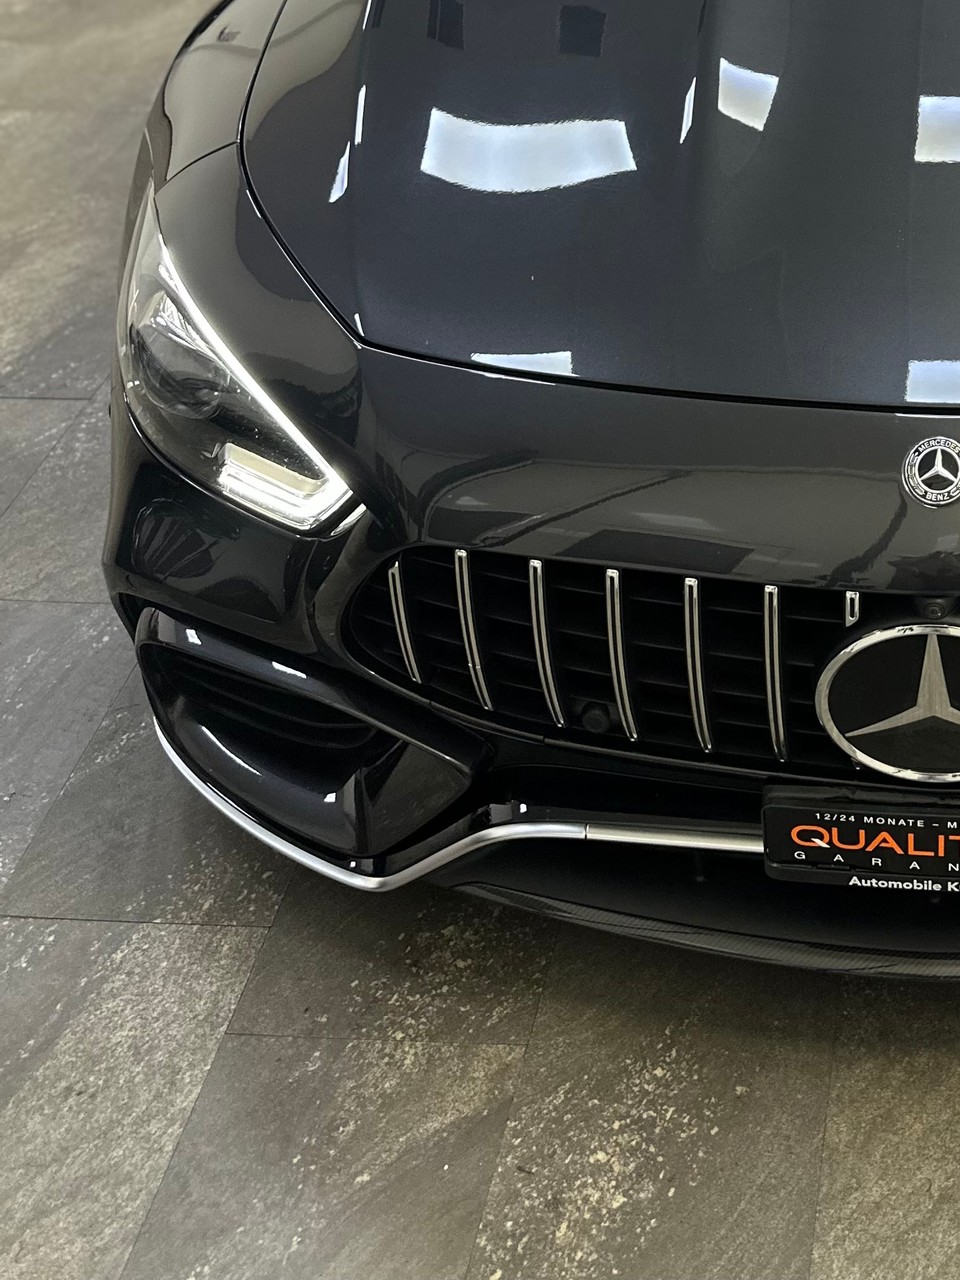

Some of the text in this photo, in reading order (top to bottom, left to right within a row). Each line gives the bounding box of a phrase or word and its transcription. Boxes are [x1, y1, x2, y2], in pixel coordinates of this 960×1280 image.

[917, 439, 960, 454] MERCEDES
[925, 492, 950, 501] BENZ
[815, 813, 856, 822] 12/24
[863, 816, 925, 827] MONATE
[849, 876, 942, 891] Automobile
